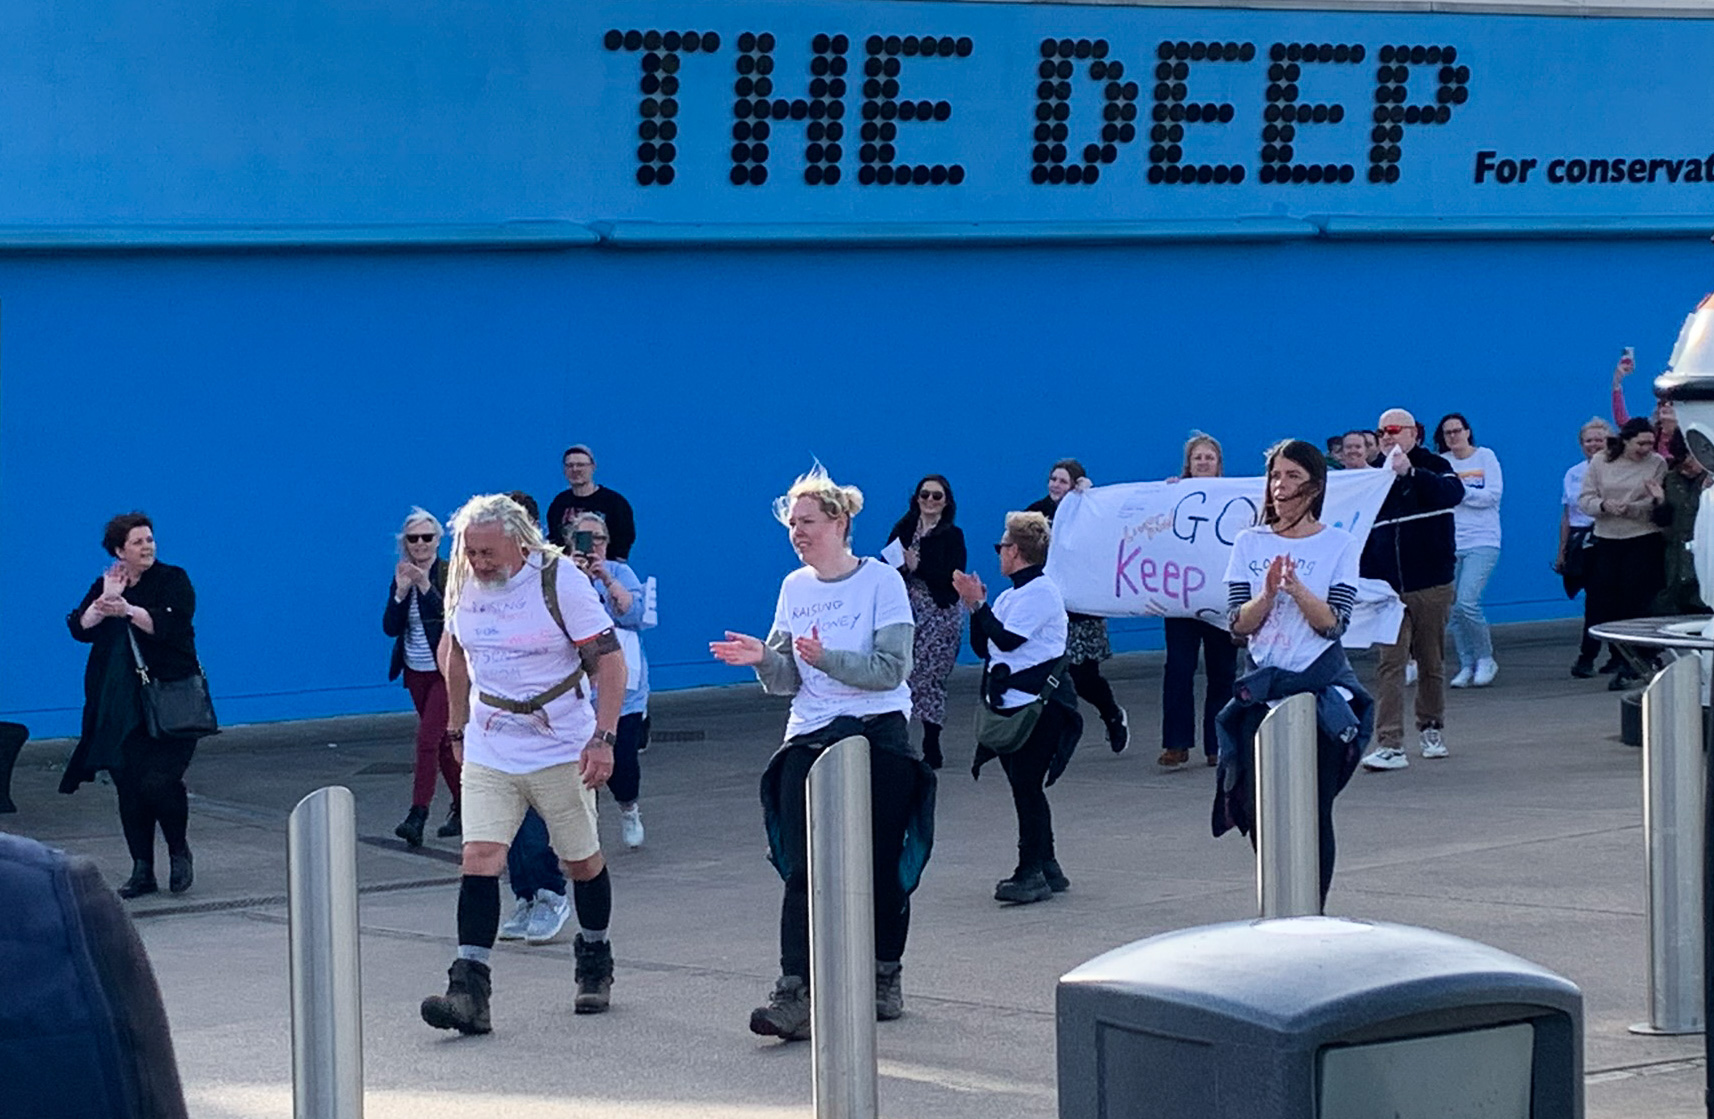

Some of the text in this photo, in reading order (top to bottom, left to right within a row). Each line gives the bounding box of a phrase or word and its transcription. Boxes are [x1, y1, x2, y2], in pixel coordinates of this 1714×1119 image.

[604, 29, 1471, 187] THE DEEP
[1474, 150, 1537, 184] For
[1115, 539, 1205, 608] Keep
